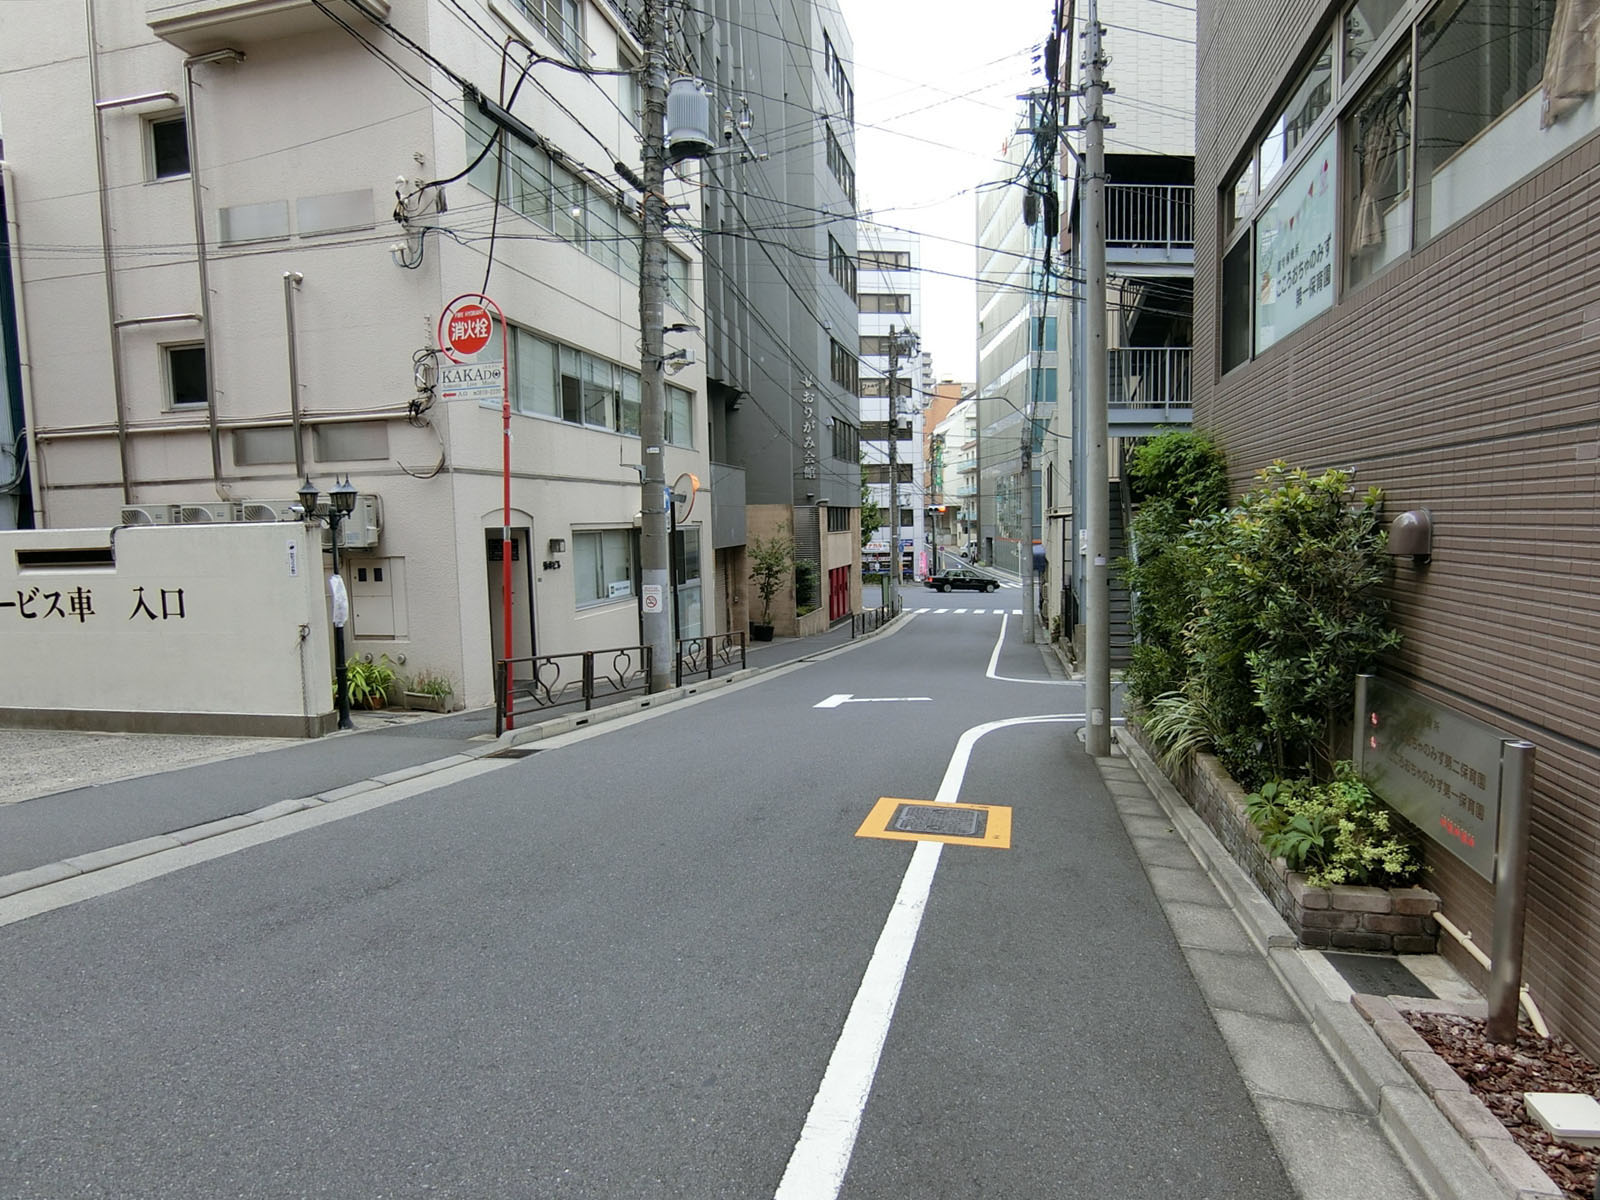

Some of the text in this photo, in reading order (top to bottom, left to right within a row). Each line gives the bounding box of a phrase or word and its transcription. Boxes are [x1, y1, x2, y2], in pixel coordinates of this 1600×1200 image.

[1296, 264, 1331, 308] 第一保育園
[451, 318, 489, 341] 消火栓
[442, 368, 501, 383] KAKADO
[802, 391, 817, 480] おりがみ会館
[129, 586, 186, 621] 入口
